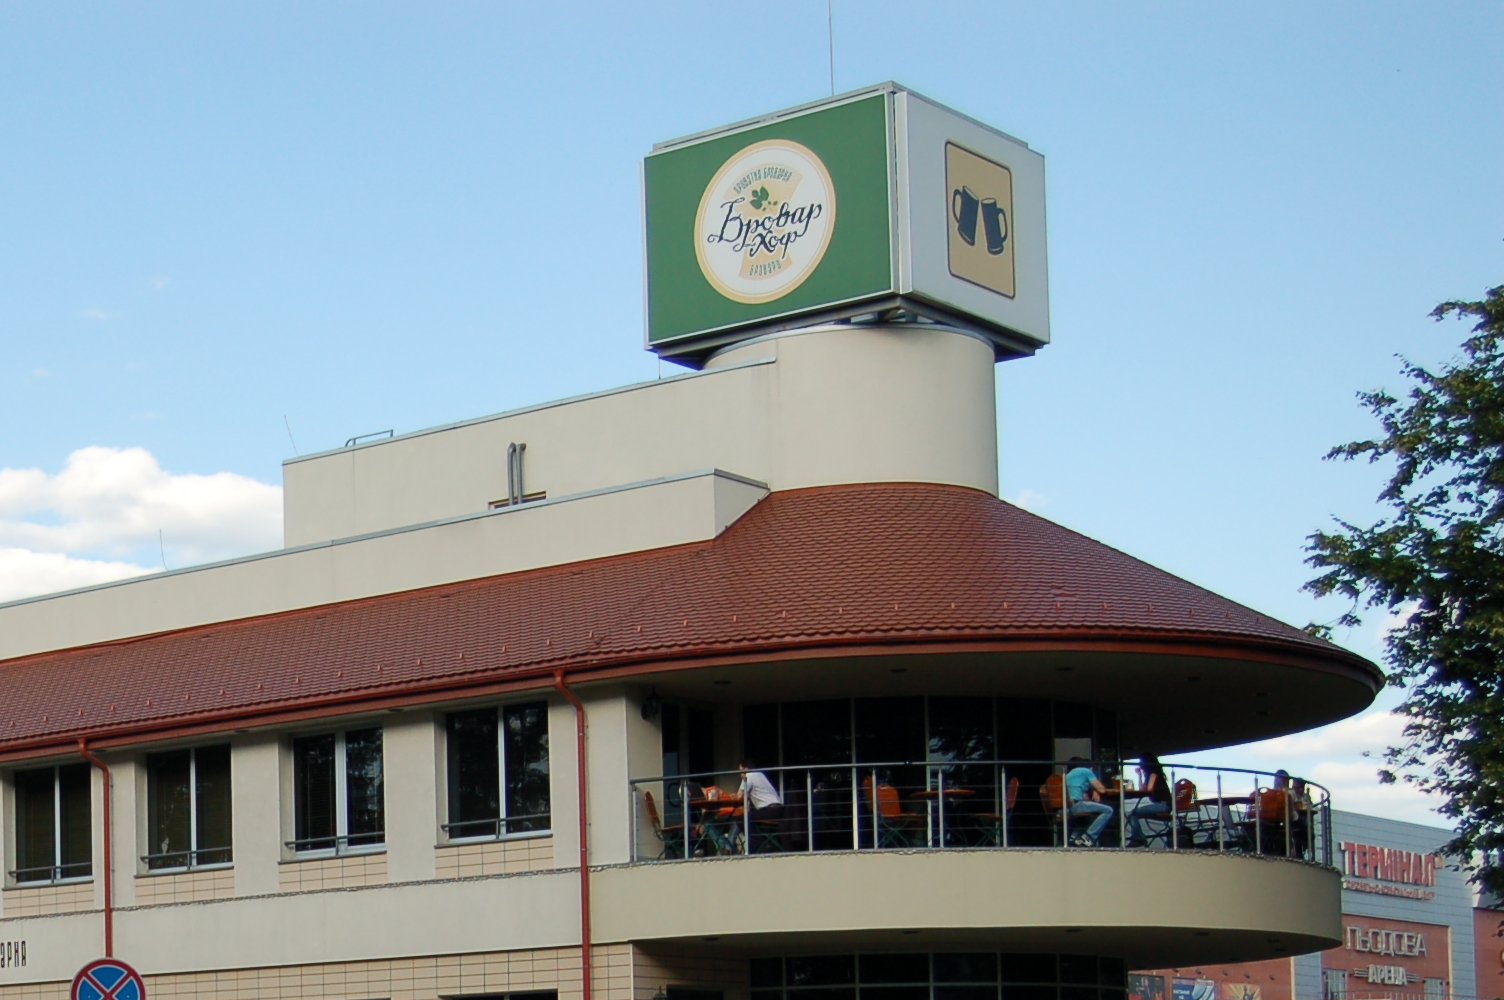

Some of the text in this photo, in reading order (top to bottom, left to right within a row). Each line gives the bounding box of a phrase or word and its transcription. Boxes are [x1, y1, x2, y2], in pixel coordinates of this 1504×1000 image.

[707, 197, 822, 253] Бровар
[1339, 841, 1437, 887] ТЕРМІНАЛ
[1346, 926, 1427, 957] ЛЬОДОВА
[1367, 964, 1409, 985] АРЕНА
